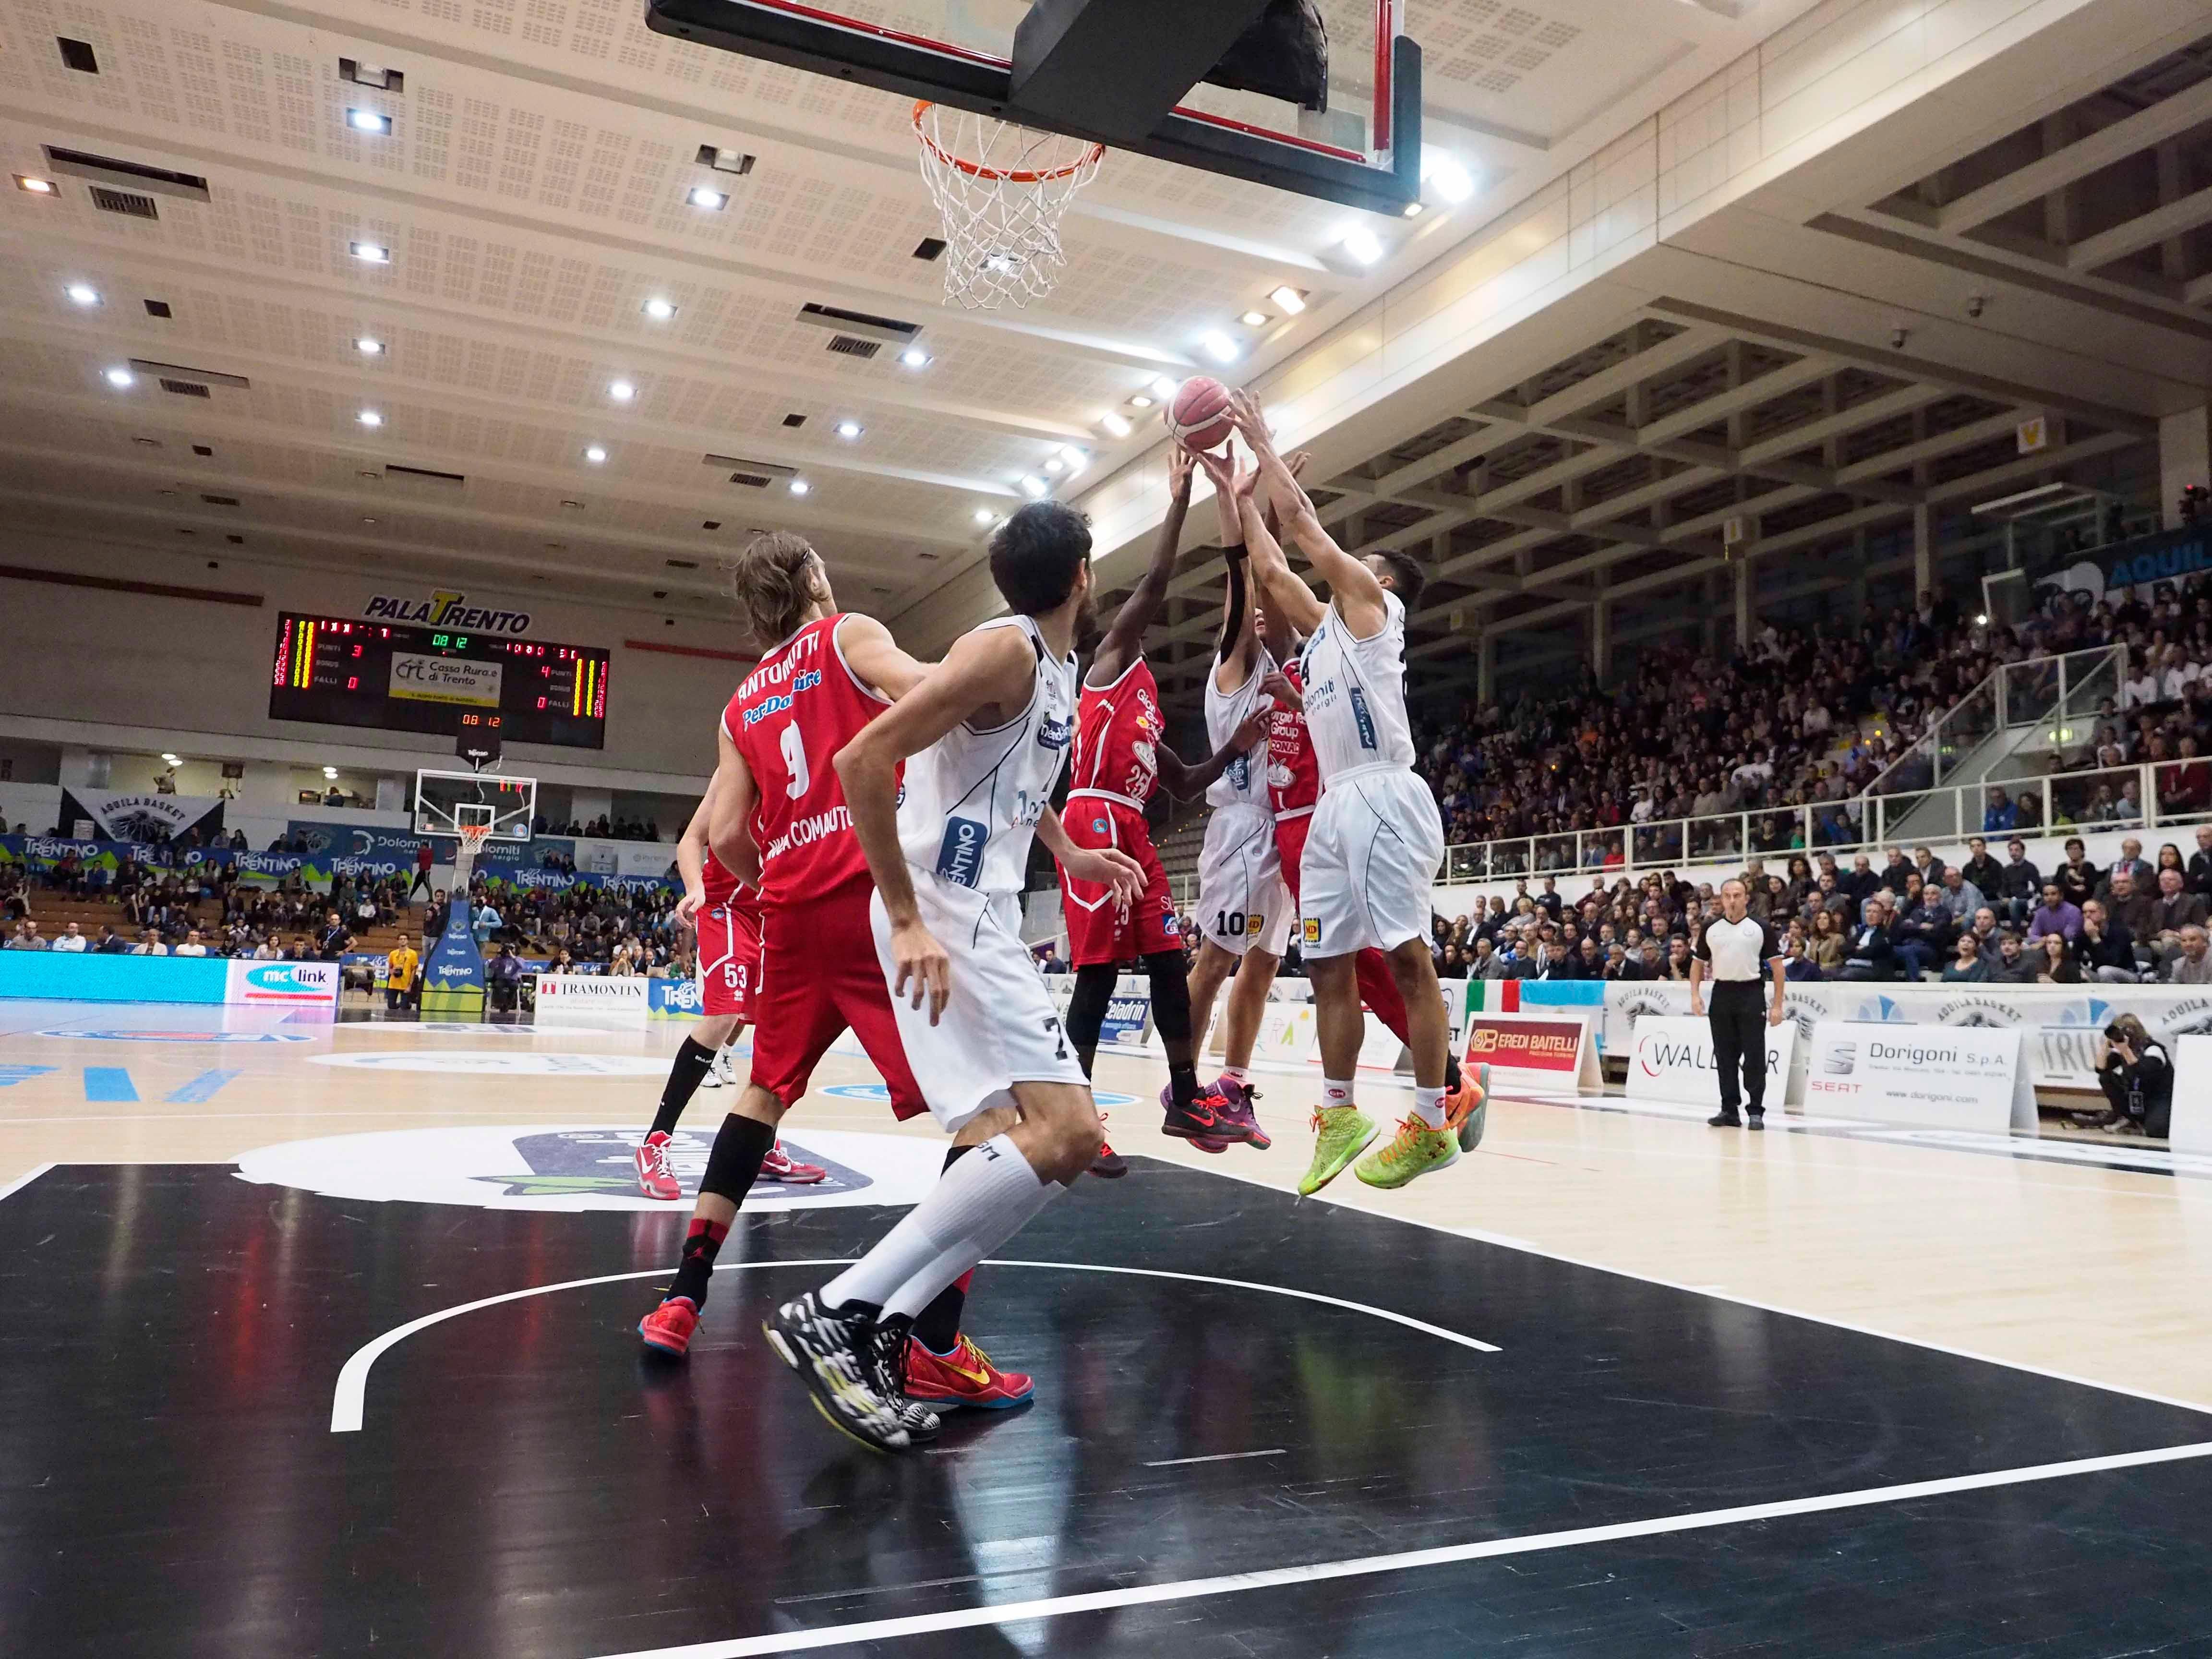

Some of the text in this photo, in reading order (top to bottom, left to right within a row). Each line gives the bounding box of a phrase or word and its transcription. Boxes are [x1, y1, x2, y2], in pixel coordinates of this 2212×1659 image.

[365, 591, 529, 633] PALATRENTO
[433, 635, 468, 648] 08 12
[443, 673, 476, 685] Trento
[463, 665, 497, 677] Rurae
[462, 714, 500, 727] 08 12
[1271, 721, 1298, 739] Group
[780, 719, 810, 800] 9
[233, 852, 301, 873] TRENTINO
[1217, 911, 1245, 936] 10
[263, 969, 327, 984] mc link
[724, 963, 747, 989] 53
[562, 983, 641, 997] TRAMONTIN
[661, 986, 703, 1009] TREN
[1938, 998, 1972, 1021] AQUILA
[2162, 998, 2210, 1025] AQUILA
[1497, 1034, 1528, 1049] EREDI
[1870, 1043, 1958, 1064] Dorigoni
[1812, 1081, 1863, 1094] SEAT
